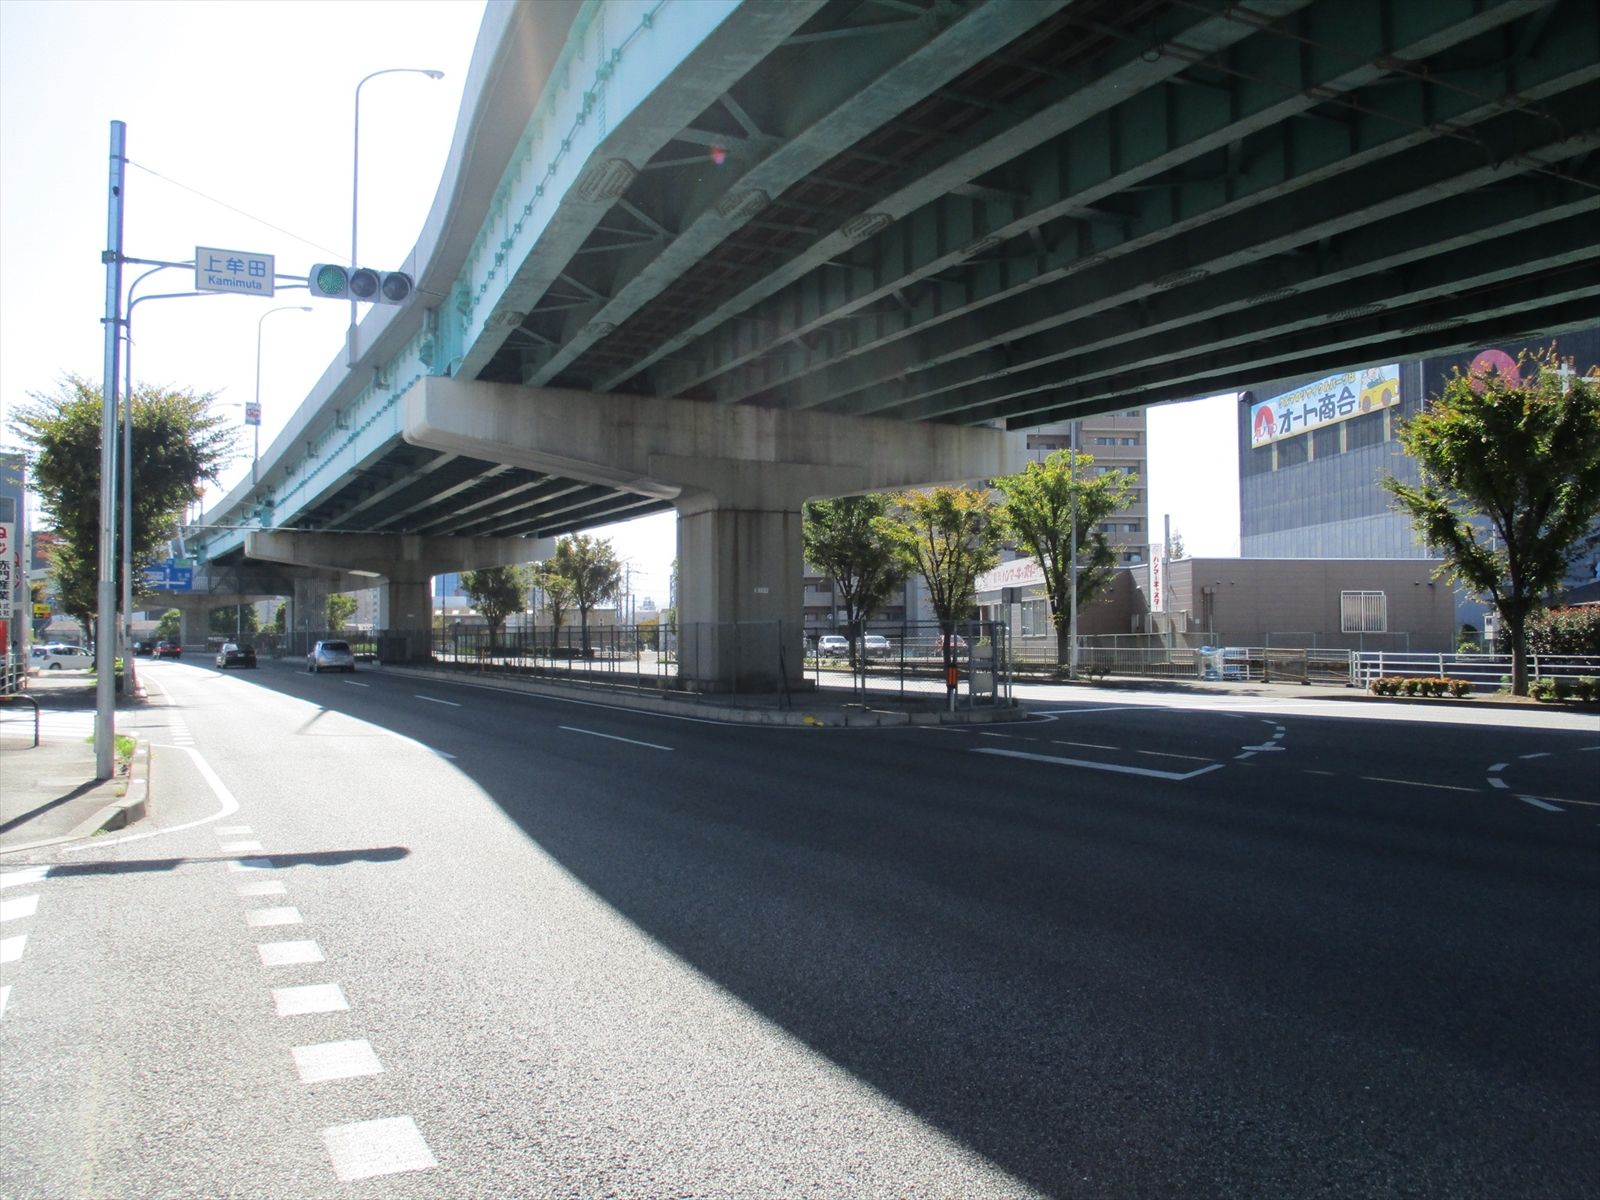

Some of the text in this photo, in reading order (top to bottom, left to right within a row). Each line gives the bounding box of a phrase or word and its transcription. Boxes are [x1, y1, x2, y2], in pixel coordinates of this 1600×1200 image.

[204, 255, 266, 277] 上牟田
[207, 275, 263, 290] Kamimuta
[1278, 385, 1356, 434] オート商会
